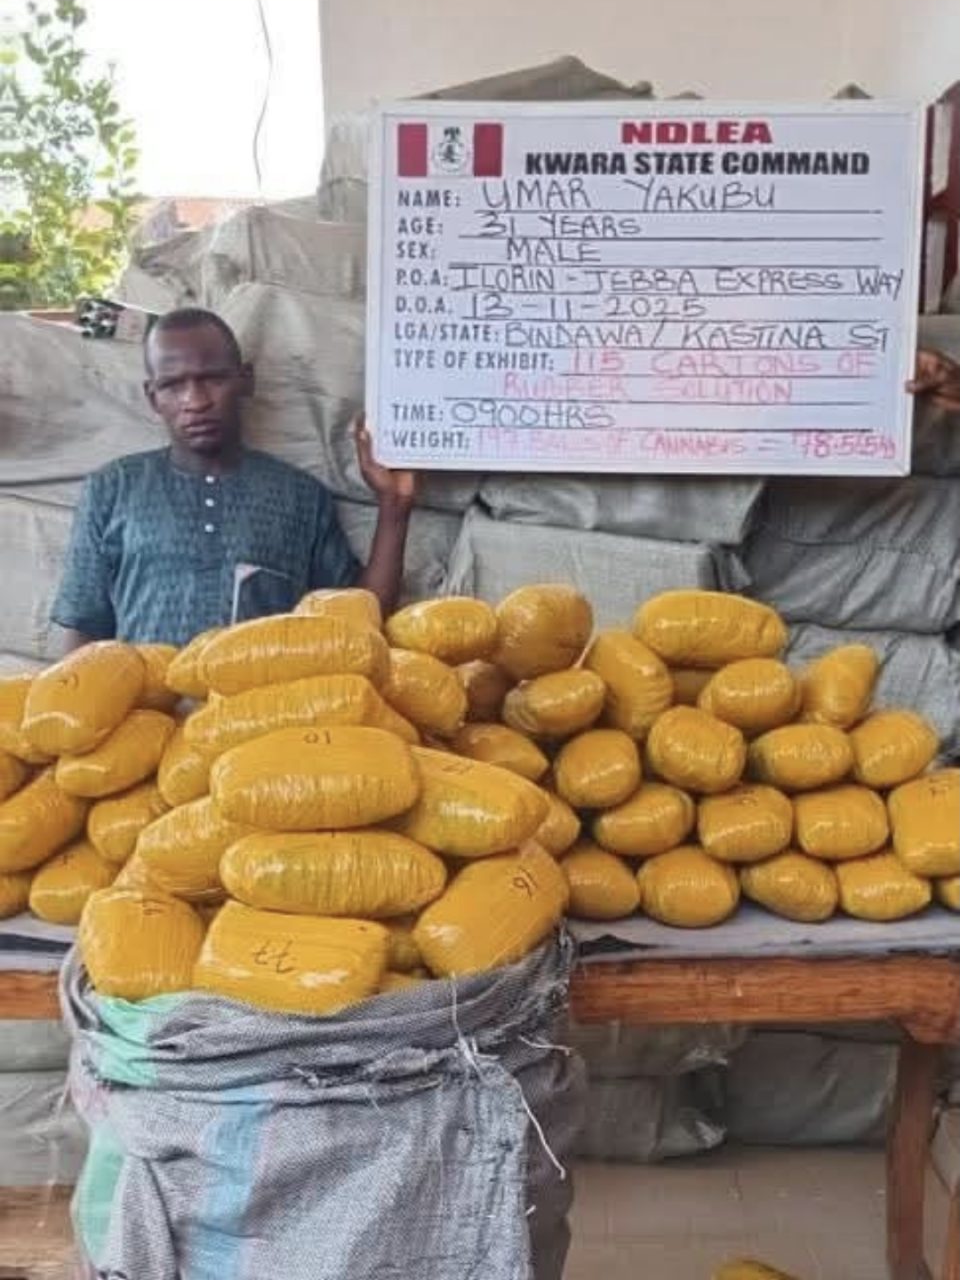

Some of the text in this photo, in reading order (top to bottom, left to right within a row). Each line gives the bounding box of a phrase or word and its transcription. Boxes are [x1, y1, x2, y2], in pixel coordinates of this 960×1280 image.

[621, 121, 773, 144] NDLEA
[525, 151, 871, 175] KWARA STATE COMMAND
[397, 177, 776, 212] NAME: UMAR YAKUBU
[397, 211, 642, 238] AGE: 31 YEARS
[396, 238, 602, 262] SEX: MALE
[450, 265, 556, 291] ILORIN
[715, 268, 844, 292] EXPRESS
[855, 269, 905, 300] WAY
[394, 323, 499, 343] LGA/STATE:
[681, 322, 827, 349] KASTINA
[394, 349, 435, 370] TYPE
[443, 350, 467, 370] OF
[475, 351, 555, 371] EXHIBIT:
[651, 352, 823, 377] CARTONS
[837, 351, 879, 376] OF
[391, 403, 444, 421] TIME:
[391, 430, 470, 450] WEIGHT:
